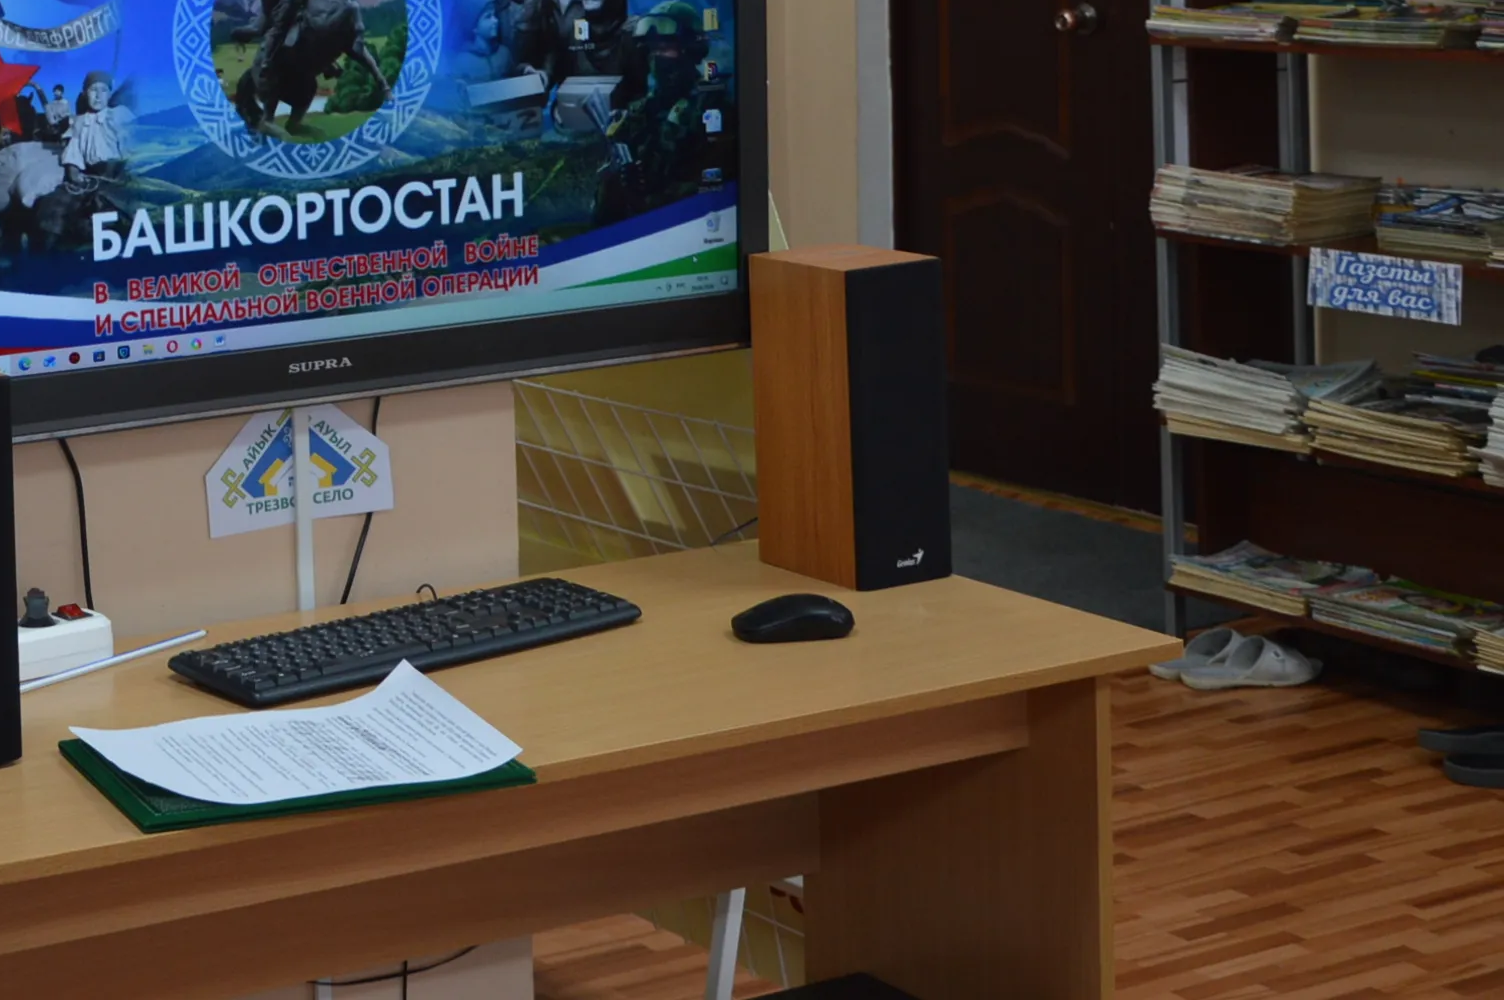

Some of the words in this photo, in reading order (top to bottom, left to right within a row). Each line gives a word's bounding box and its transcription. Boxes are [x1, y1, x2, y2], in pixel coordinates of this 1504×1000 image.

[92, 171, 523, 262] БАШКОРТОСТАН
[94, 281, 110, 305] В
[127, 262, 241, 301] ВЕЛИКОЙ
[258, 240, 448, 287] ОТЕЧЕСТВЕННОЙ
[464, 233, 539, 265] ВОЙНЕ
[1338, 254, 1436, 286] Газеты
[95, 313, 112, 337] И
[120, 287, 299, 334] СПЕЦИАЛЬНОЙ
[305, 275, 417, 313] ВОЕННОЙ
[422, 264, 539, 298] ОПЕРАЦИИ
[1332, 286, 1382, 309] для
[1386, 284, 1434, 311] вас
[288, 357, 353, 374] SUPRA
[314, 420, 352, 455] АУЫЛ
[312, 488, 354, 505] СЕЛО
